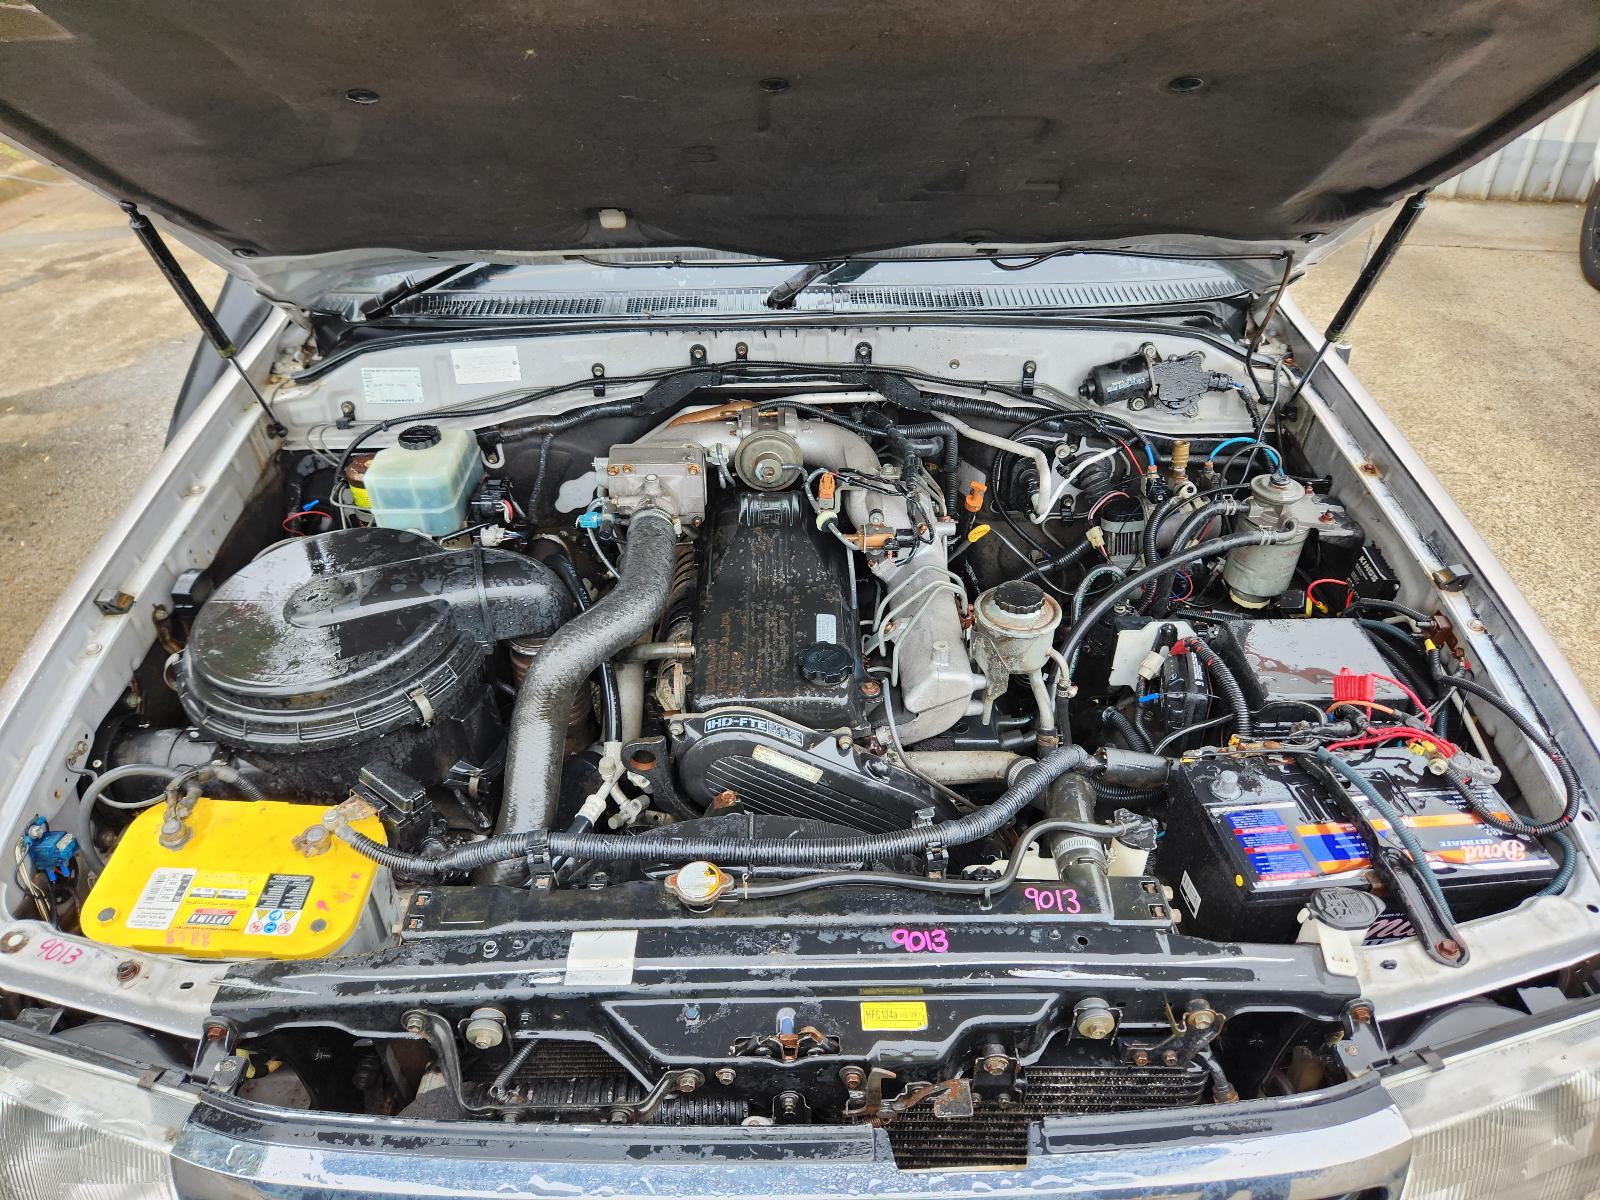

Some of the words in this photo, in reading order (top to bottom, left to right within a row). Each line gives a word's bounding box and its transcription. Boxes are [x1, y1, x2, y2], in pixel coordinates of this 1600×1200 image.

[1358, 555, 1379, 583] KINGS
[706, 717, 767, 731] 1HD-FTE
[1439, 838, 1493, 849] ULTIMATE
[1461, 839, 1526, 864] Bond
[1025, 887, 1081, 914] 9013
[189, 913, 234, 926] OPTIMA
[39, 938, 84, 965] 9013
[891, 928, 949, 954] 9013
